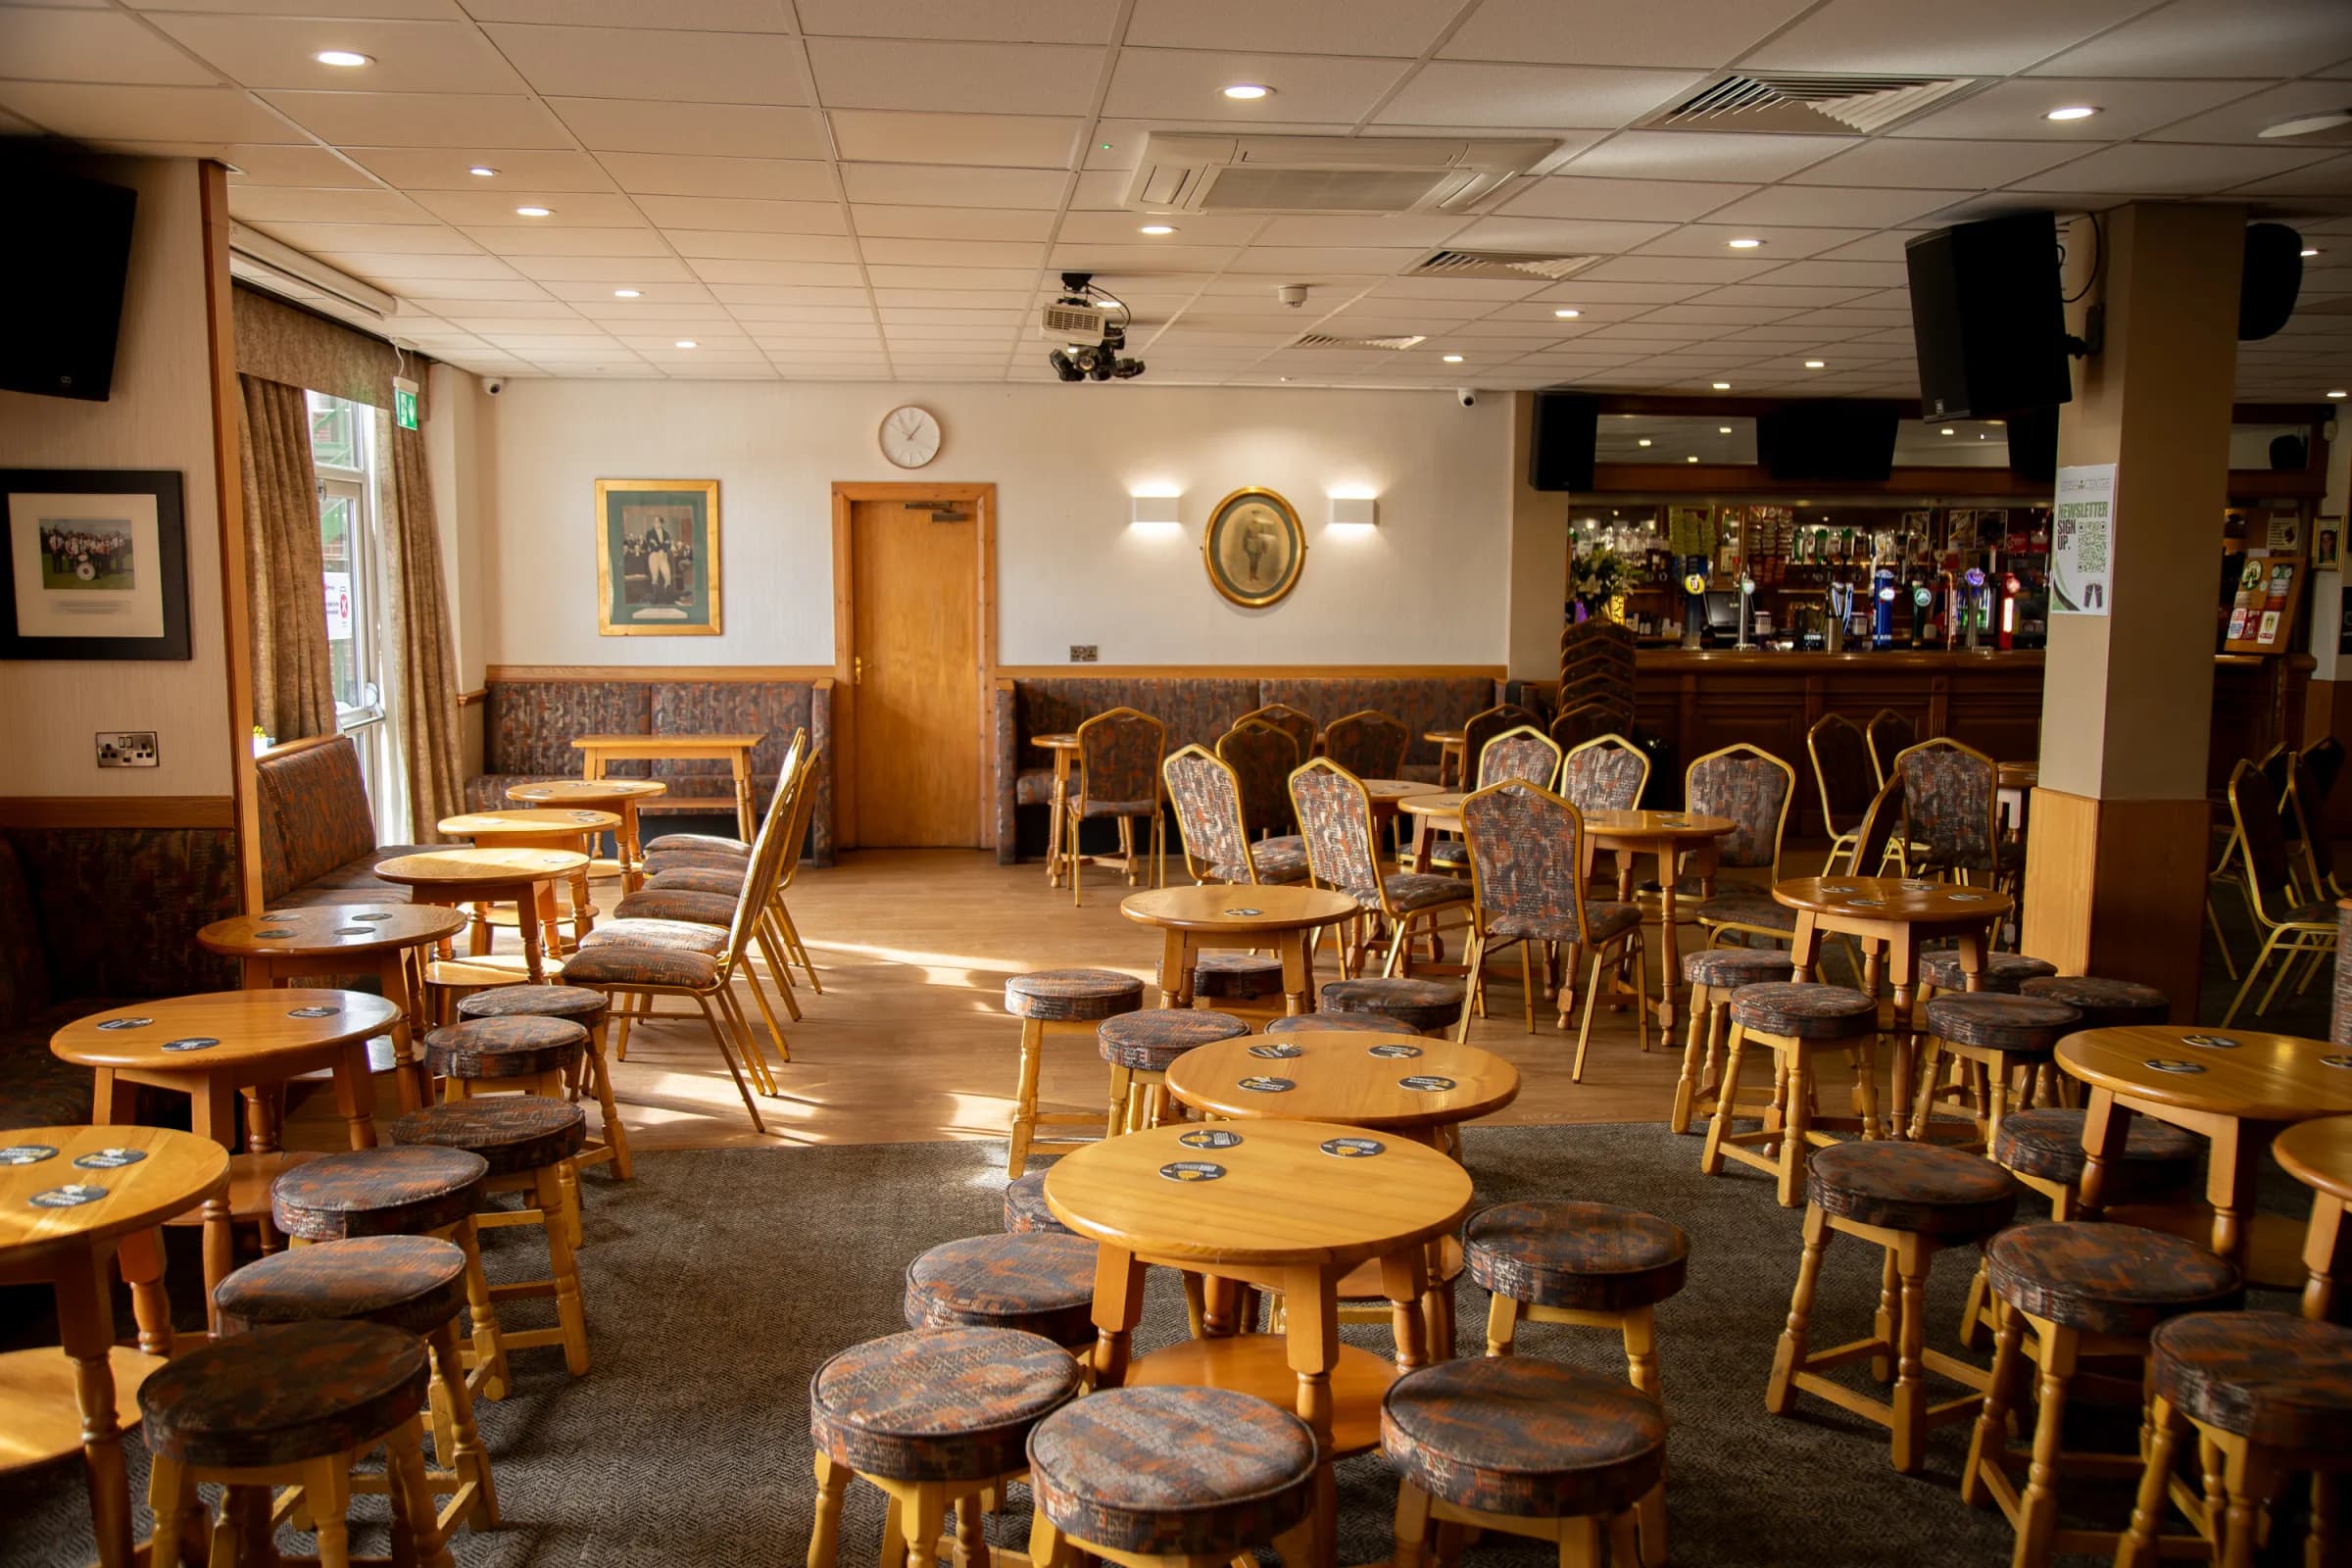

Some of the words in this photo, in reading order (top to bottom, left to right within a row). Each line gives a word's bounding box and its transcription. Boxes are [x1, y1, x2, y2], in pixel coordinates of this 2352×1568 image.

[2058, 502, 2108, 518] NEWSLETTER
[2057, 519, 2076, 534] SIGN
[2057, 535, 2071, 551] UP.
